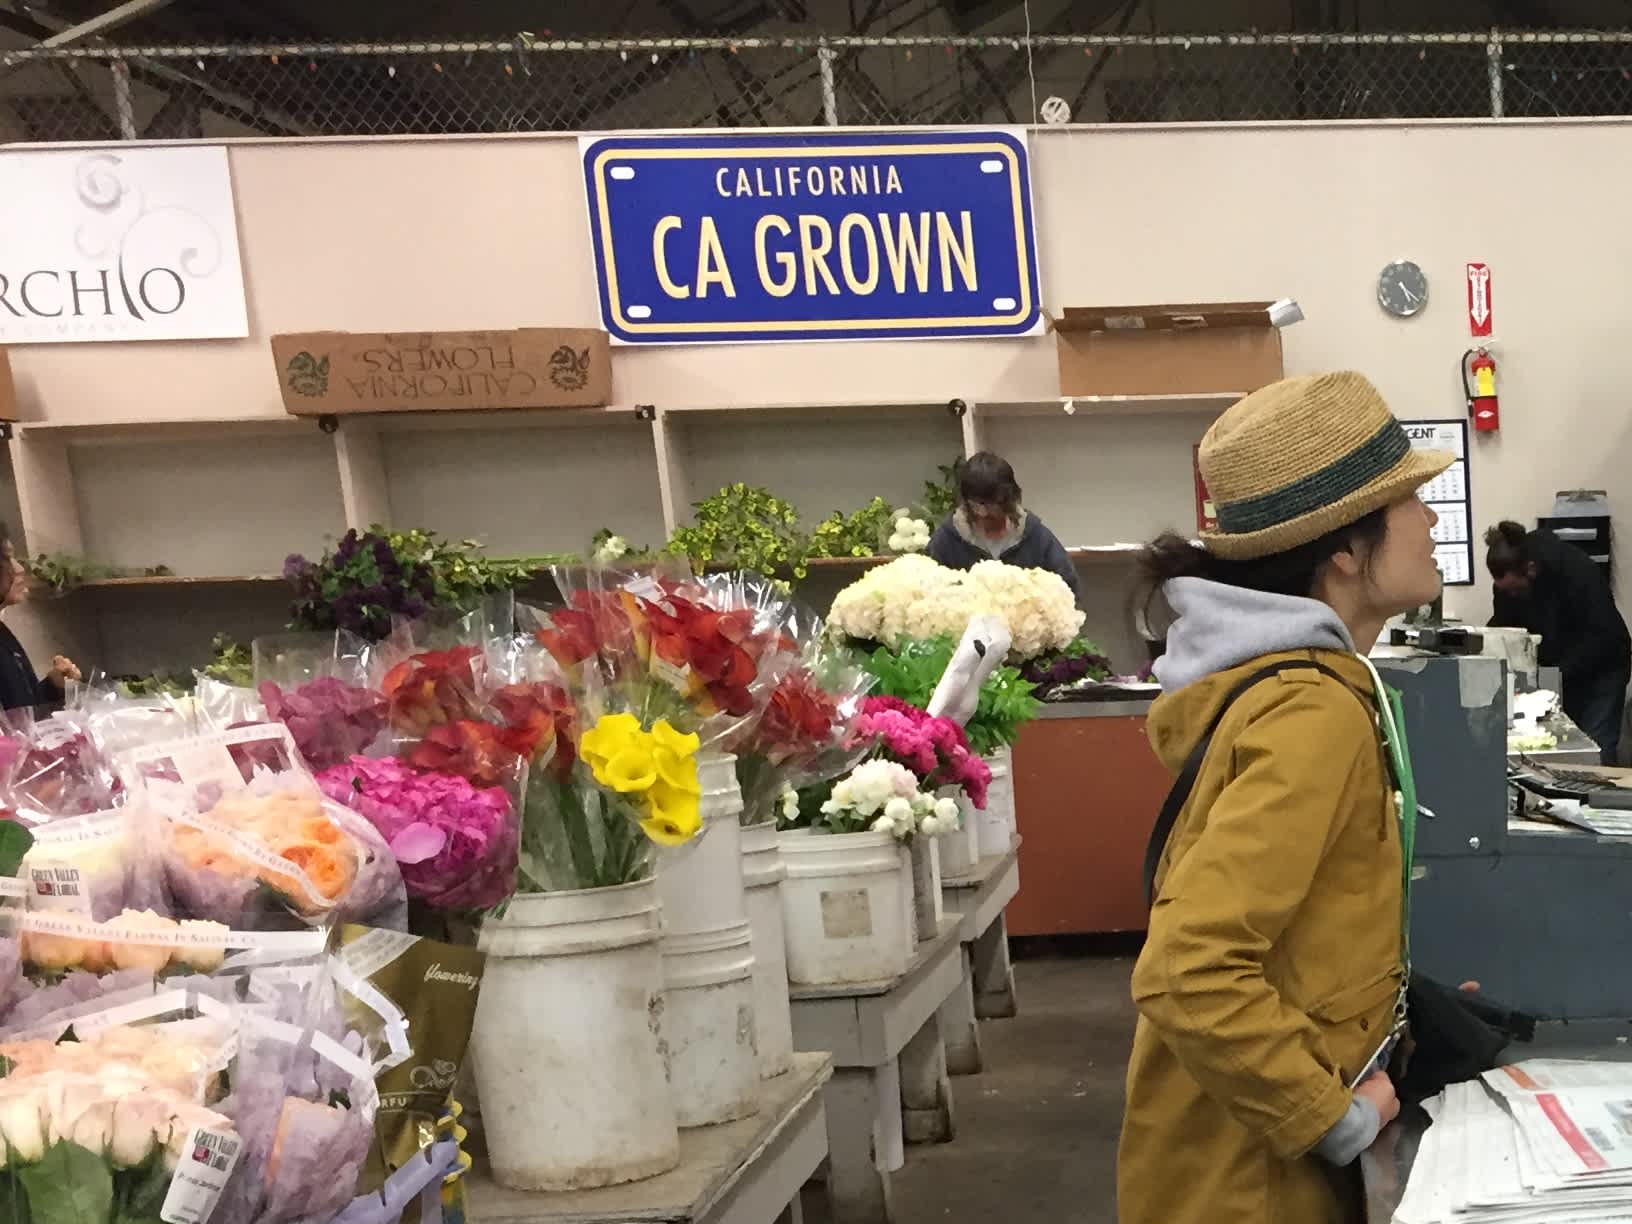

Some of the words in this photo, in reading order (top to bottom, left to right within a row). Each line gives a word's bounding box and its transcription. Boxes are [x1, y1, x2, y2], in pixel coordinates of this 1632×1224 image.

[716, 165, 903, 197] CALIFORNIA
[653, 214, 737, 299] CA
[754, 210, 978, 297] GROWN
[362, 345, 516, 373] FLOWERS
[344, 371, 537, 400] CALIFORNIA
[31, 868, 53, 881] GREEN
[54, 867, 80, 882] VALLEY
[53, 883, 81, 896] FLORAL
[424, 962, 479, 991] flowering
